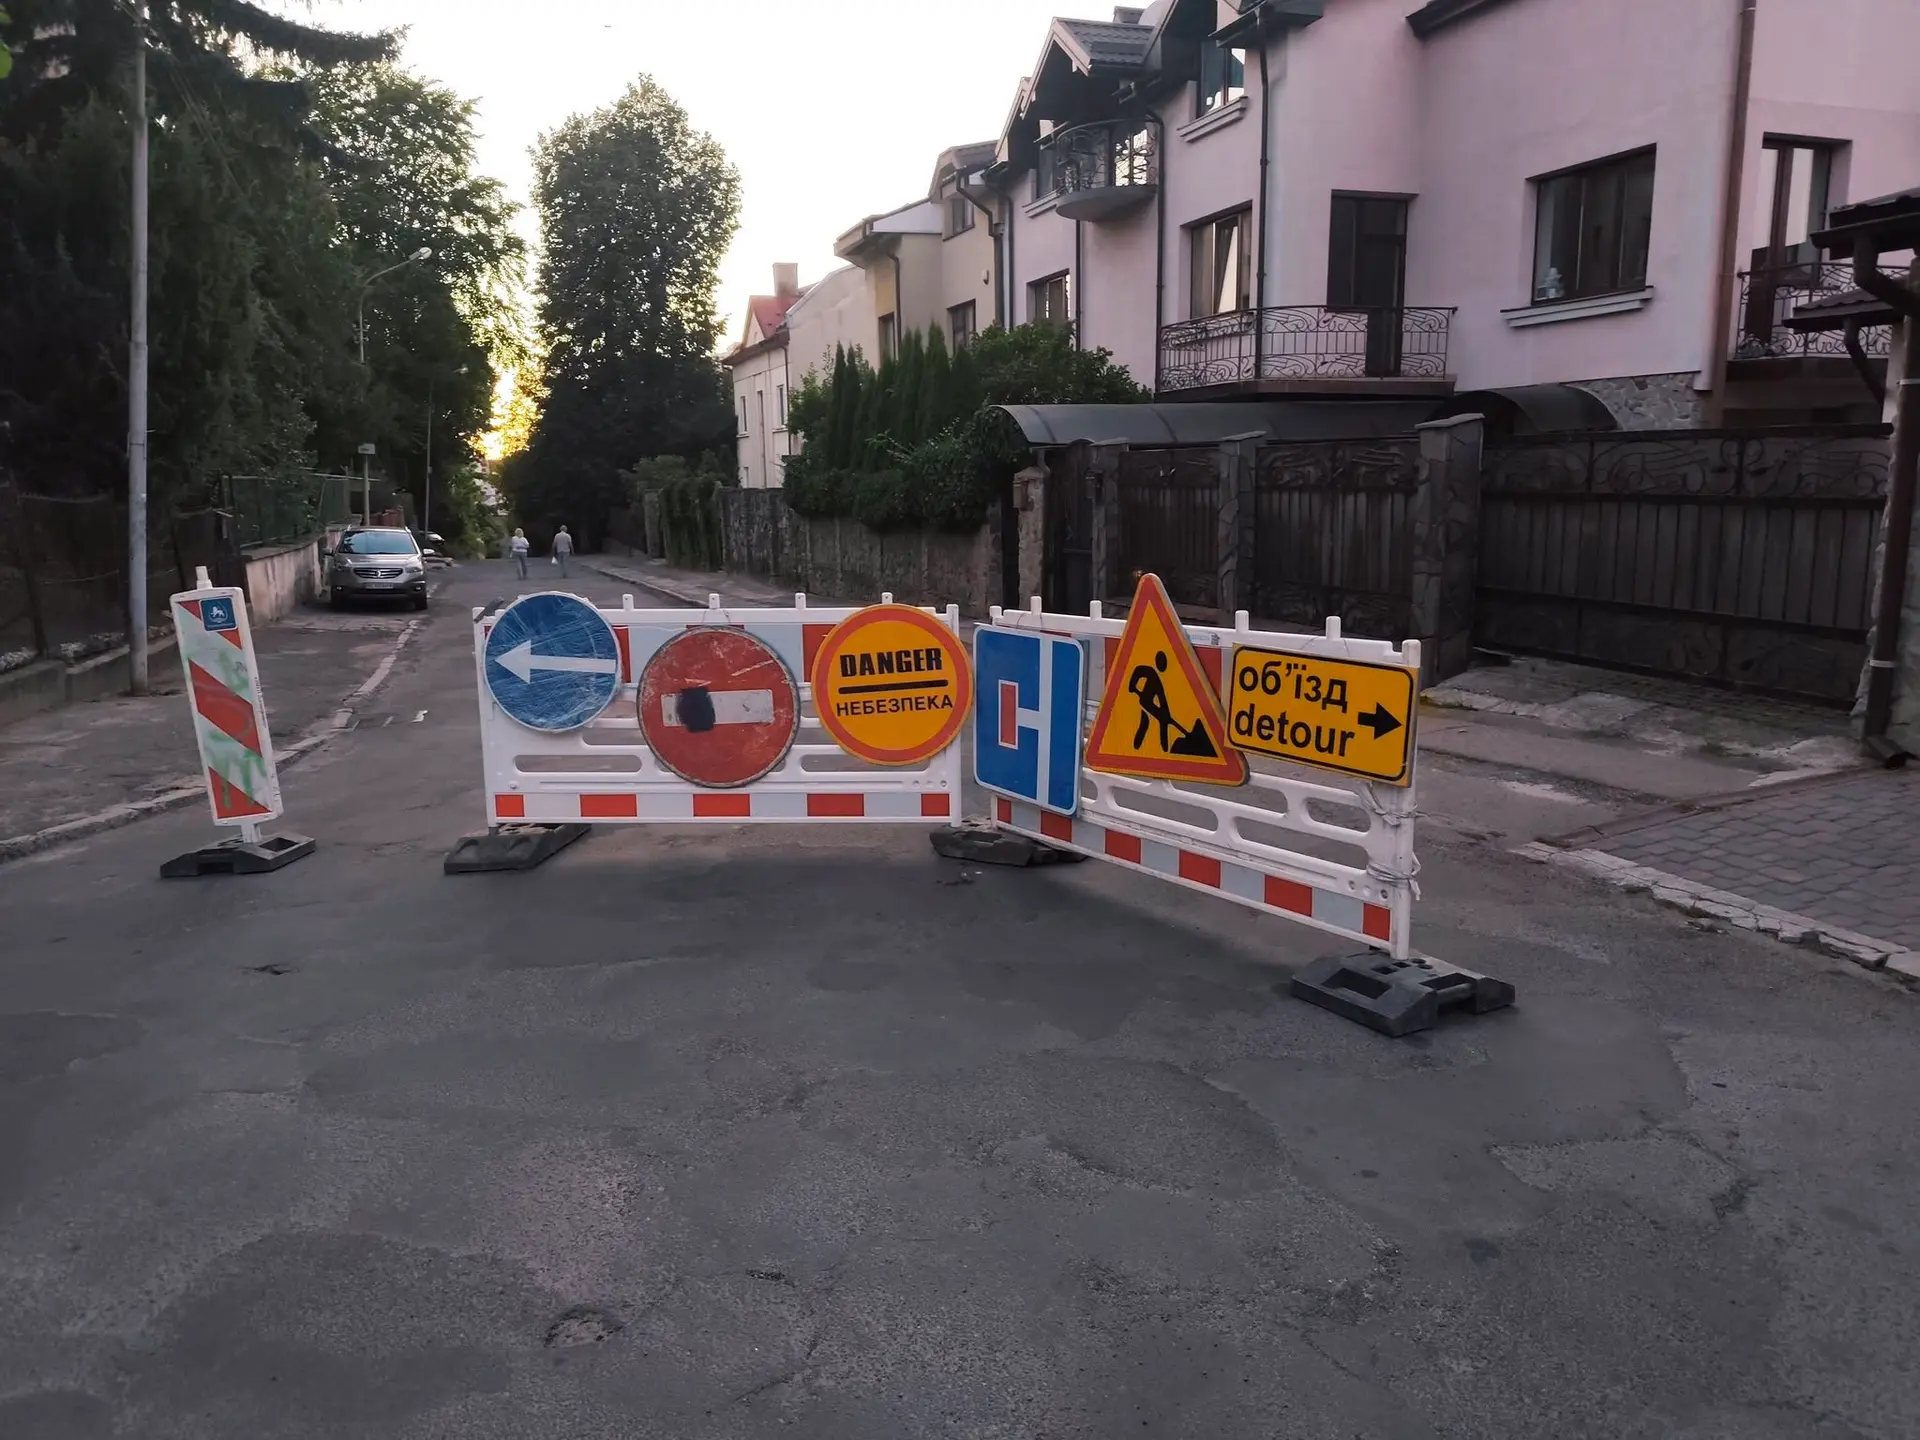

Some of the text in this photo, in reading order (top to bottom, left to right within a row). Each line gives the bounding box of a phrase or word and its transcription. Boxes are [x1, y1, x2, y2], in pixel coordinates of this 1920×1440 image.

[840, 648, 942, 677] DANGER
[836, 694, 953, 716] НЕБЕЗПЕКА
[1234, 703, 1355, 757] detour
